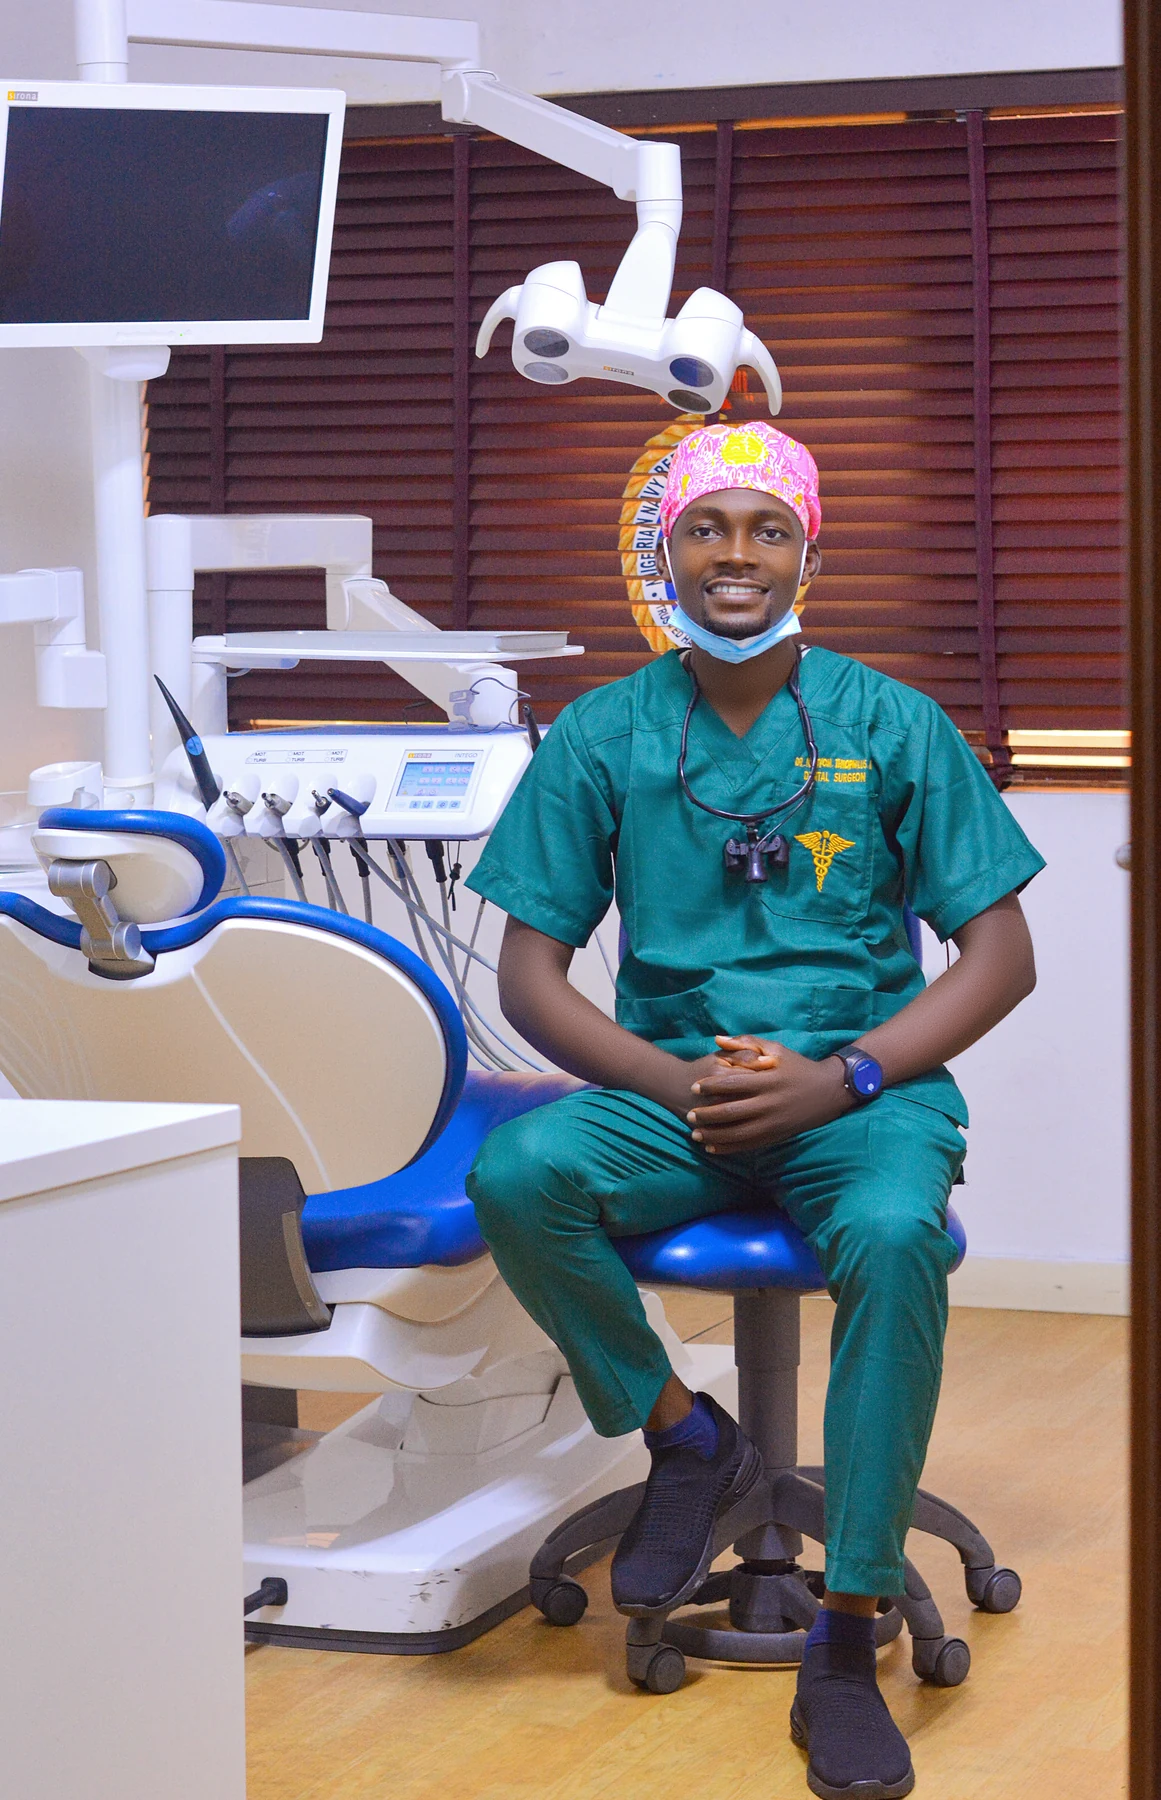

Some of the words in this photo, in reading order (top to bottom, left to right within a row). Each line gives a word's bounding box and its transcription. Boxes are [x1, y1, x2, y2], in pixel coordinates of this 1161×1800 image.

[8, 91, 38, 101] sirona
[640, 478, 665, 515] NAVY
[833, 772, 866, 783] SURGEON
